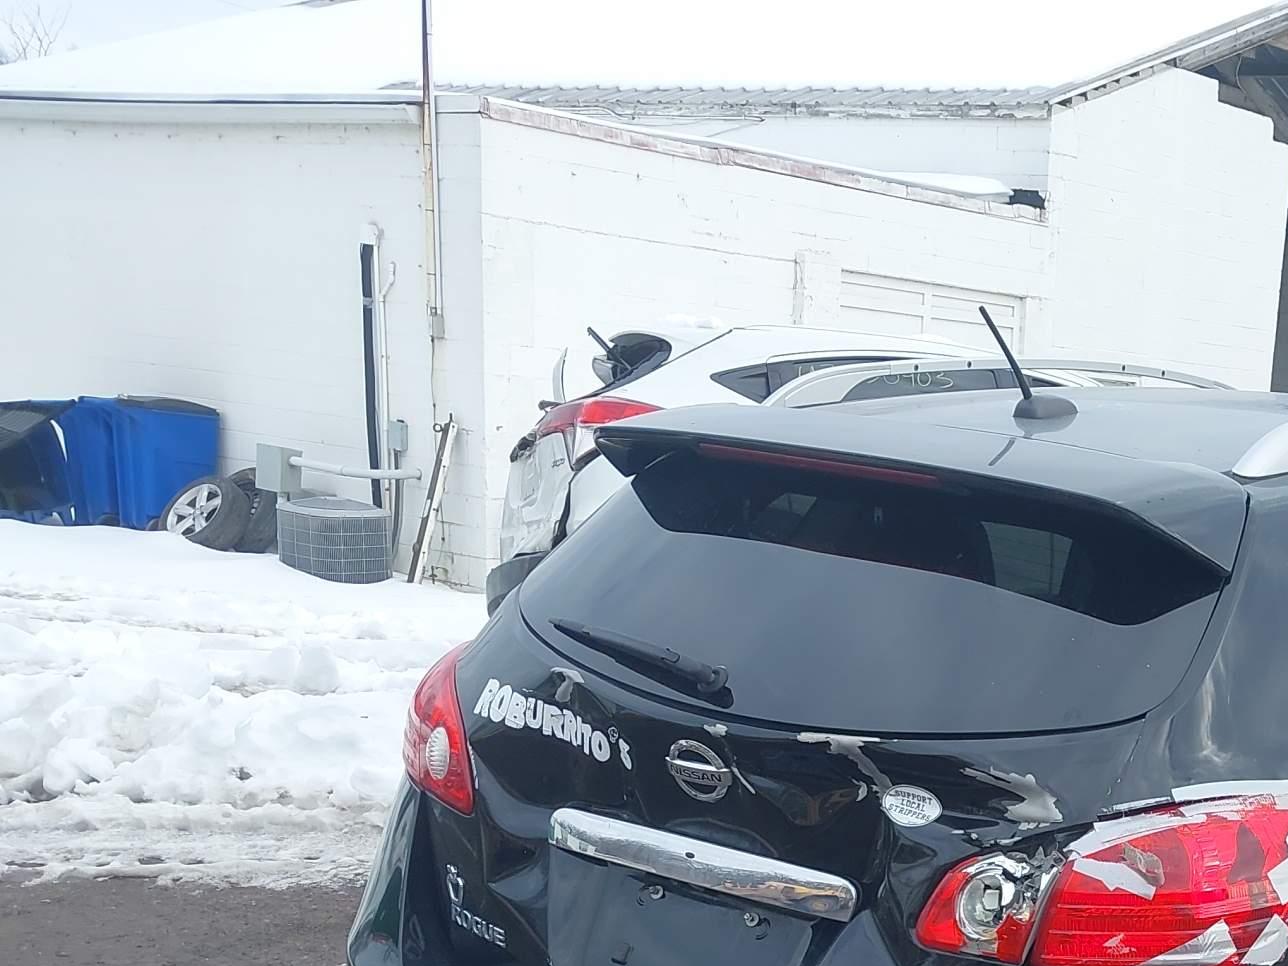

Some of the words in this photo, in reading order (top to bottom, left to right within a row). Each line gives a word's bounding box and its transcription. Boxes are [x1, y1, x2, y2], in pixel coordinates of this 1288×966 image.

[671, 763, 722, 782] NISSAN
[894, 790, 933, 805] SUPPORT
[901, 799, 926, 812] LOCAL
[888, 803, 932, 822] STRIPPERS
[451, 902, 507, 948] ROGUE
